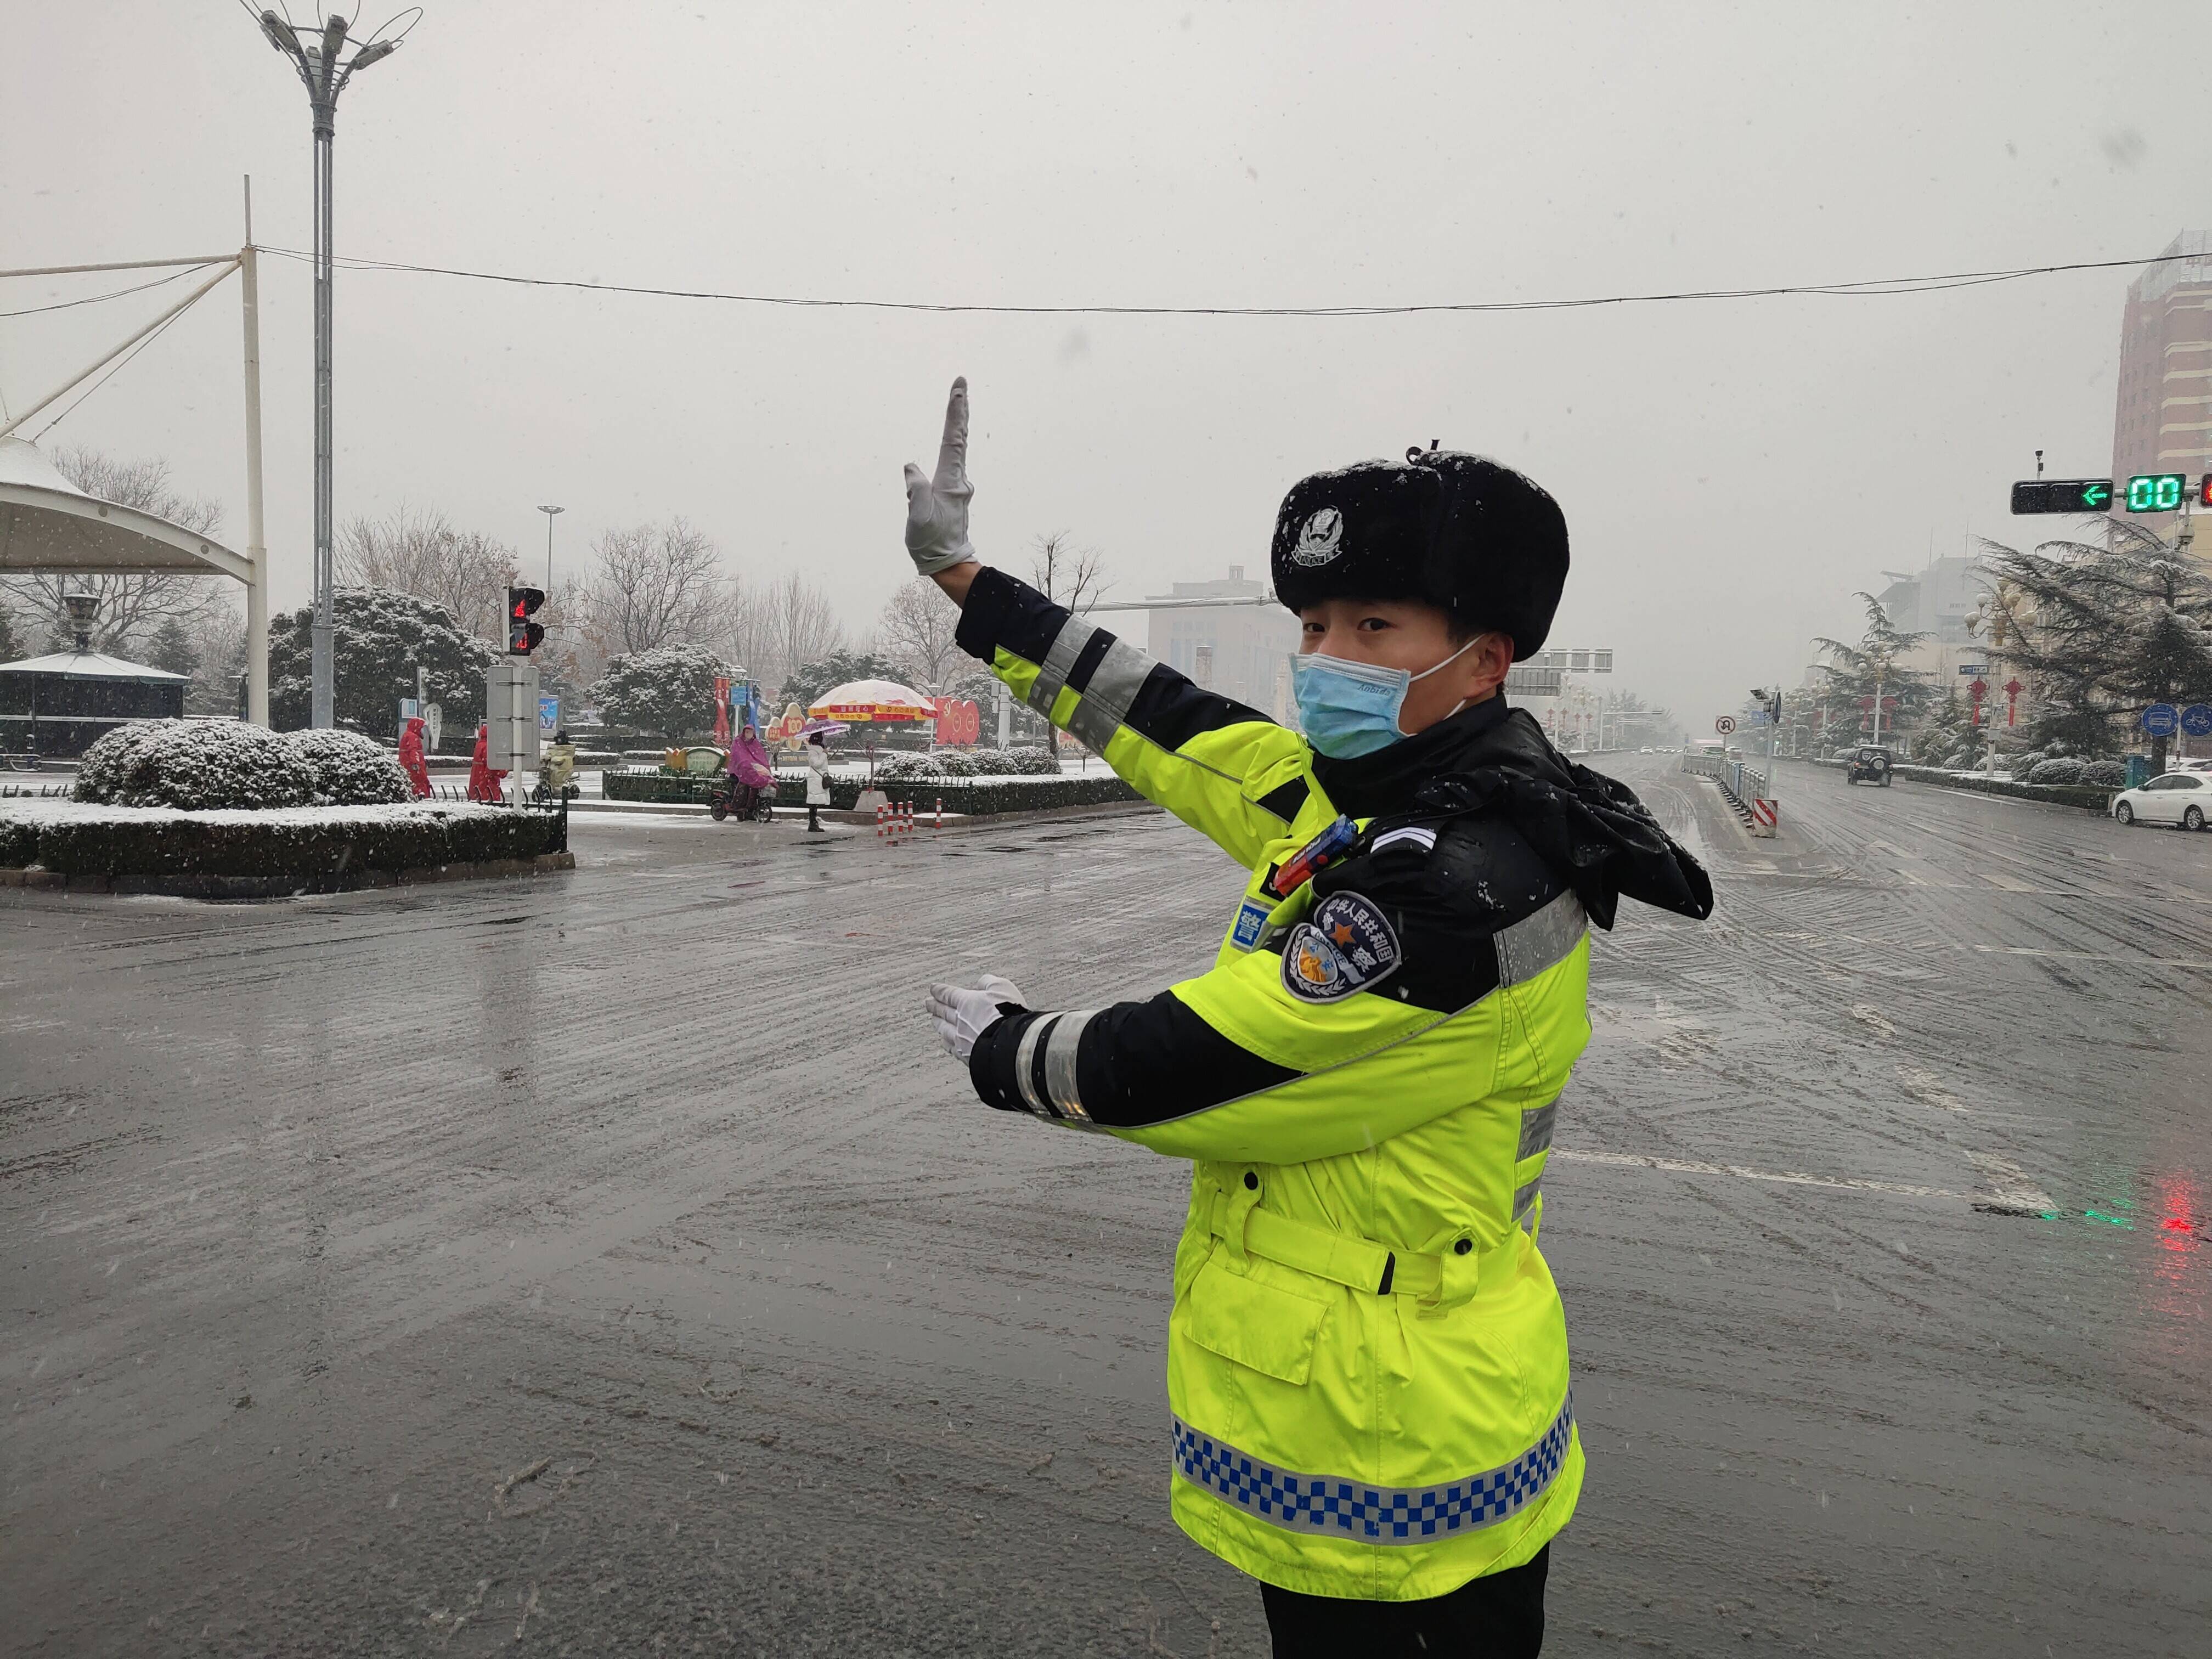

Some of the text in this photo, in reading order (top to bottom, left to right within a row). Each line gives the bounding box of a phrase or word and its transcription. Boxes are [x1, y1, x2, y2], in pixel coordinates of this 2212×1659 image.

[2131, 478, 2179, 509] 00
[1357, 684, 1391, 696] Anbida
[787, 719, 803, 733] 100
[1238, 911, 1262, 941] 警
[1326, 898, 1394, 963] 中华人民共和国
[1314, 931, 1346, 965] POCE
